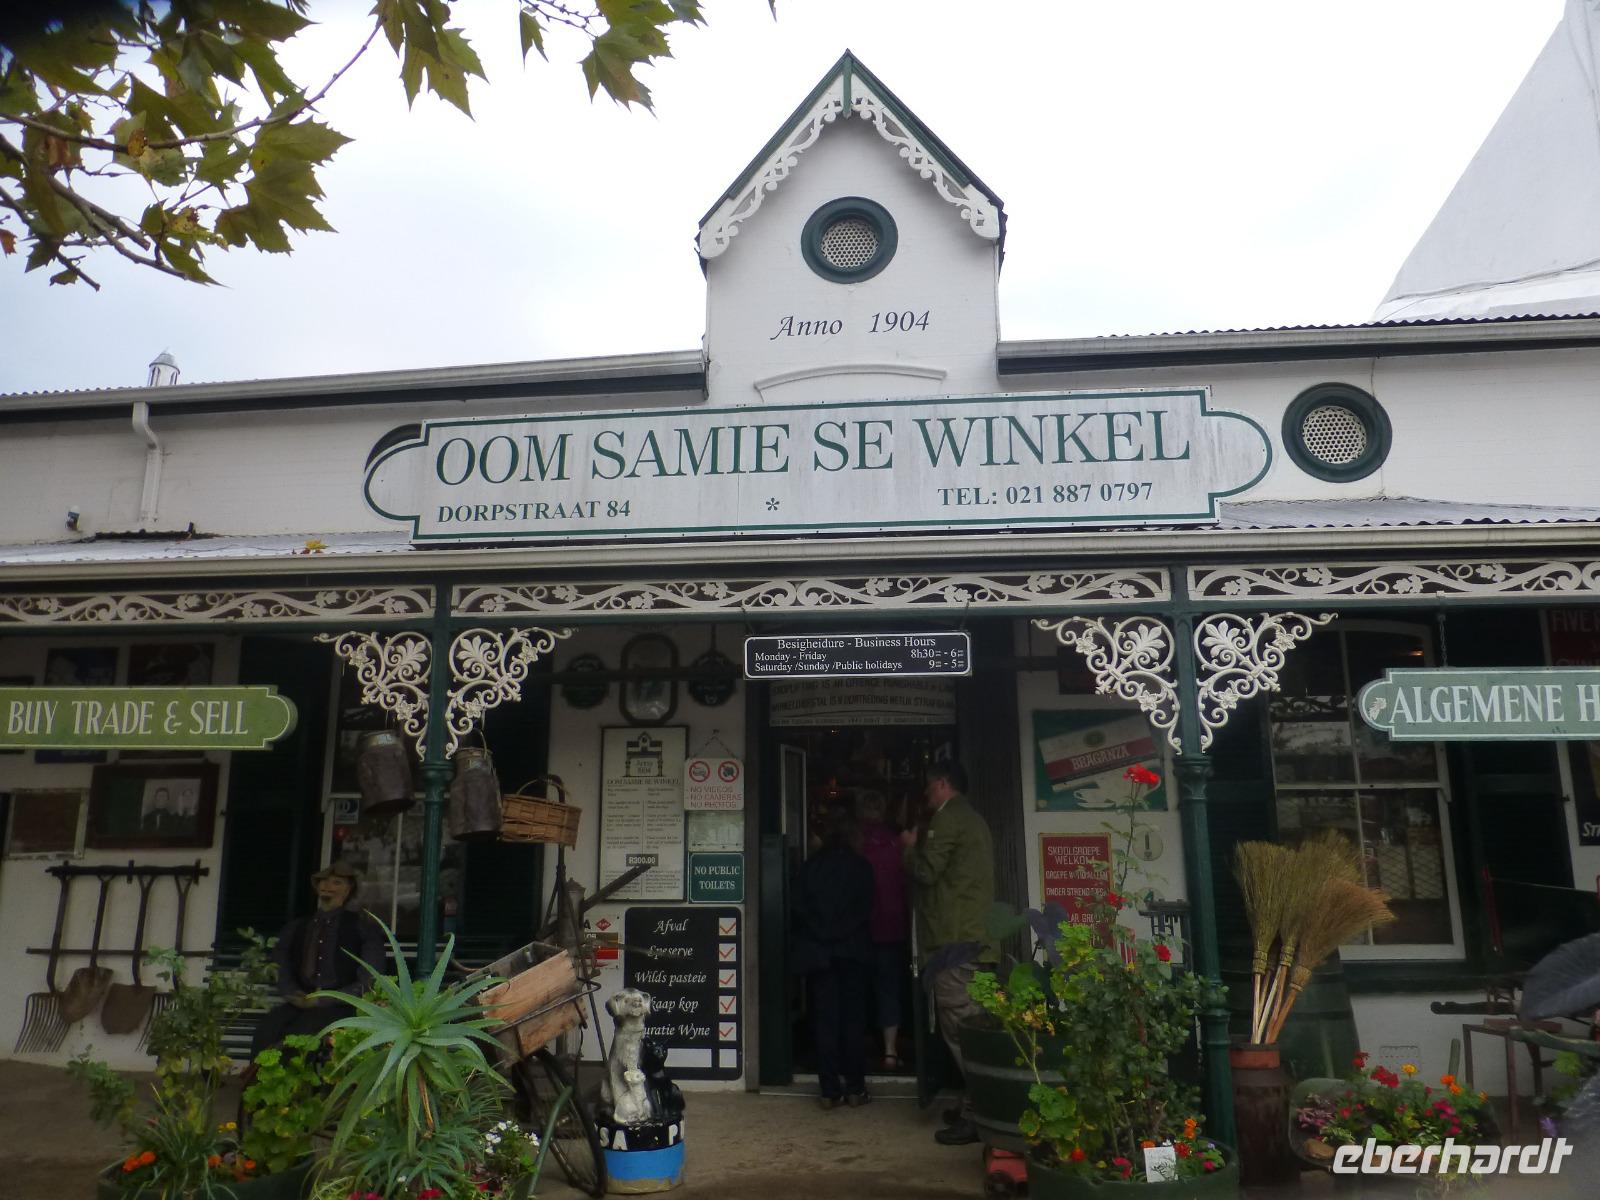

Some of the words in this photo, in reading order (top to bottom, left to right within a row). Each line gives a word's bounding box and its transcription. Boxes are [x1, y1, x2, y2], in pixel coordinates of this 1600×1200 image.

[770, 315, 843, 341] Anno
[867, 310, 931, 333] 1904
[436, 433, 574, 486] OOM
[591, 423, 790, 480] SAMIE
[813, 419, 893, 472] SE
[911, 410, 1191, 468] WINKEL
[937, 487, 997, 506] TEL:
[1006, 485, 1043, 505] 021
[1053, 483, 1091, 504] 887
[1100, 482, 1153, 502] 0797
[437, 500, 600, 523] DORPSTRAAT
[607, 499, 631, 518] 84
[777, 638, 845, 651] Besigheidure
[854, 637, 901, 648] Business
[904, 637, 937, 647] Hours
[754, 652, 791, 662] Monday
[799, 652, 827, 662] Friday
[754, 662, 792, 672] Saturday
[865, 660, 903, 671] holidays
[1389, 684, 1565, 723] ALGEMENE
[7, 700, 59, 734] BUY
[71, 700, 155, 734] TRADE
[164, 700, 182, 734] &
[189, 700, 249, 735] SELL
[1070, 745, 1130, 770] BRAGANZA
[690, 785, 702, 793] NO
[690, 793, 702, 801] NO
[694, 866, 707, 875] NO
[708, 866, 740, 875] PUBLIC
[699, 880, 736, 890] TOILETS
[653, 918, 690, 935] Afval
[634, 971, 667, 983] Wilds
[668, 971, 707, 987] pasteie
[649, 996, 676, 1014] kaap
[678, 996, 699, 1012] kop
[644, 1024, 675, 1036] uratie
[678, 1021, 711, 1040] Wyne
